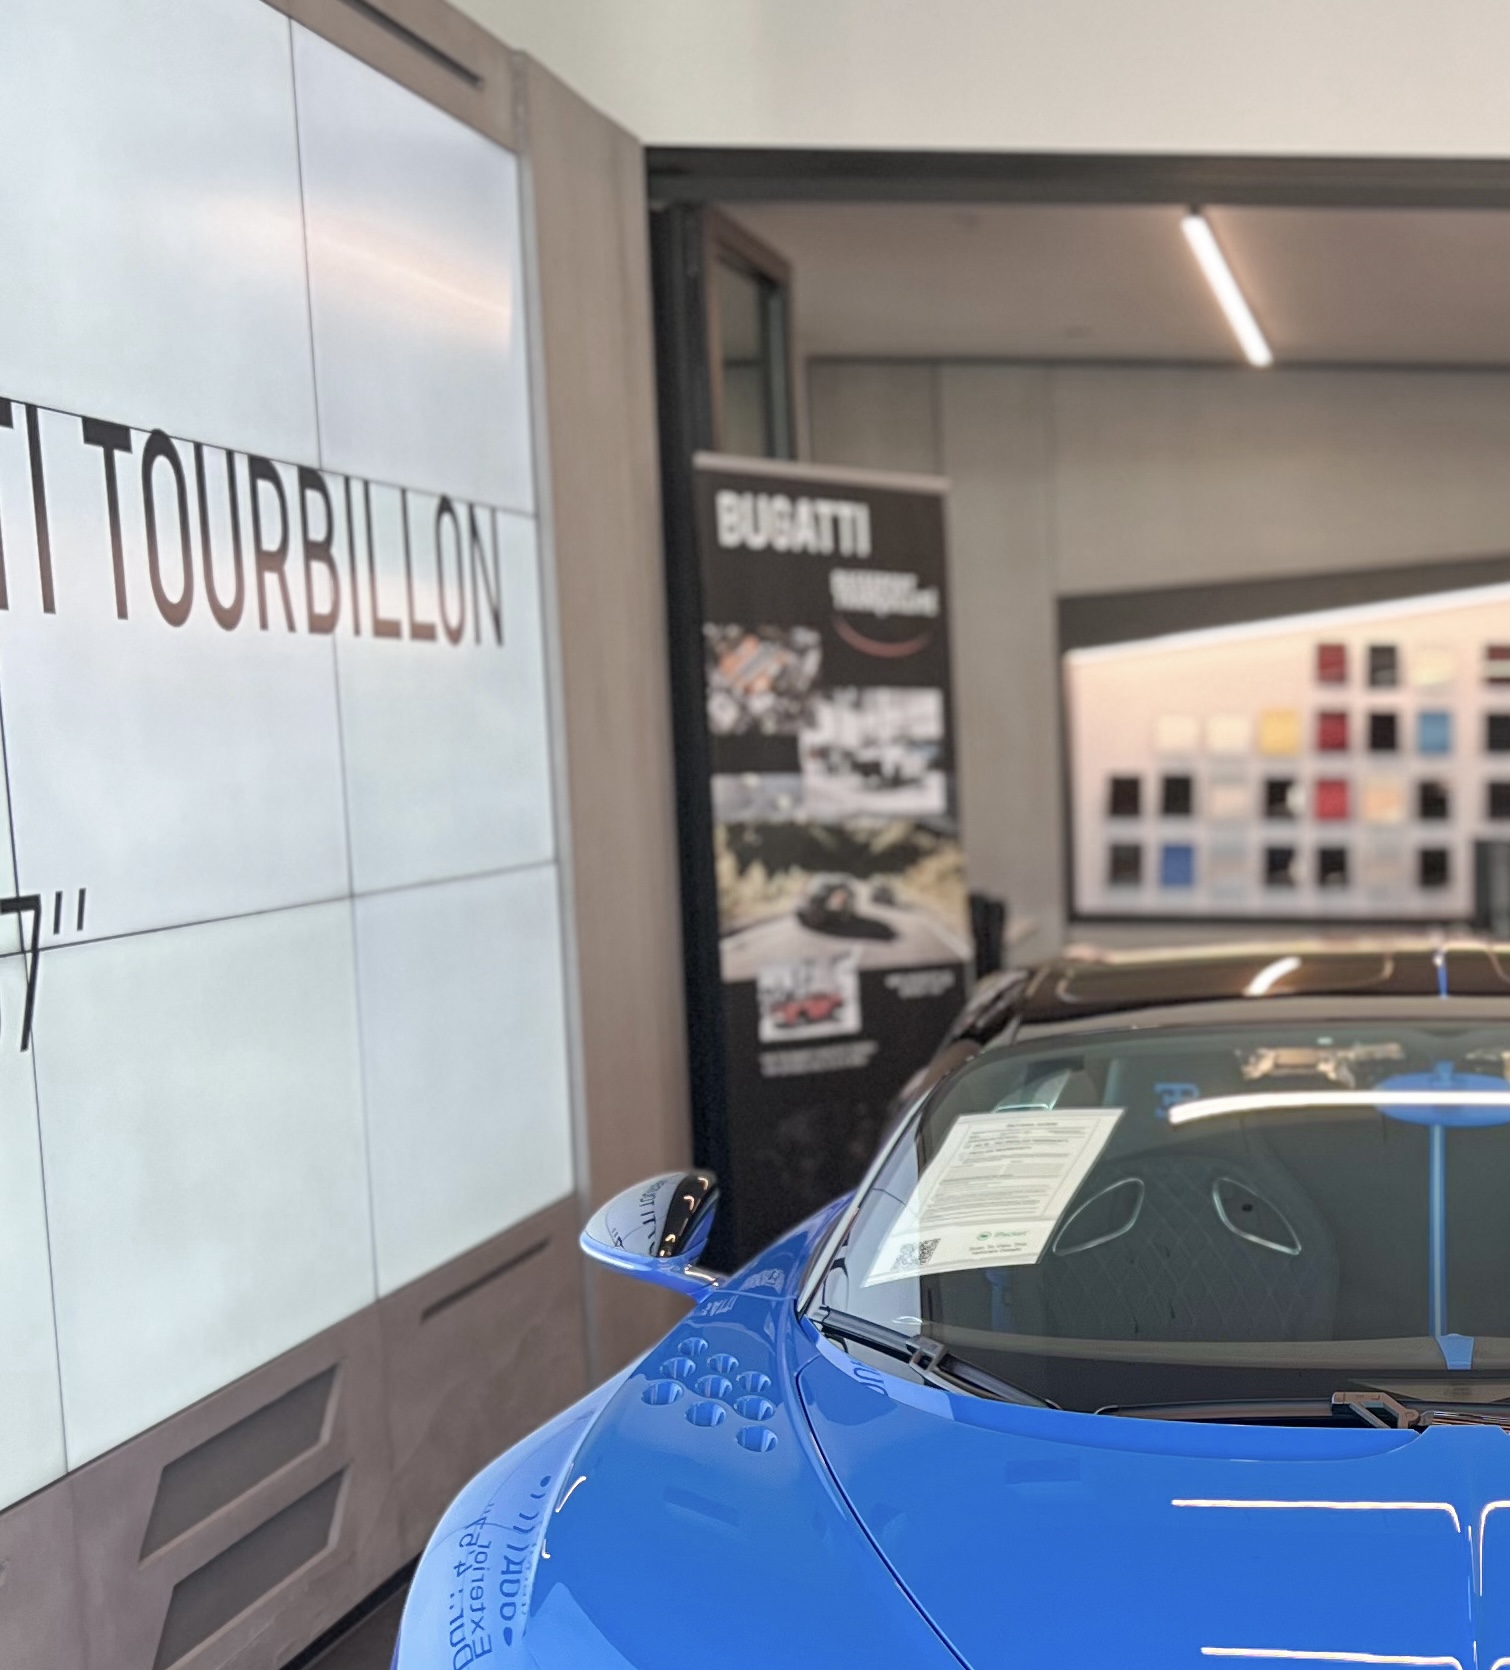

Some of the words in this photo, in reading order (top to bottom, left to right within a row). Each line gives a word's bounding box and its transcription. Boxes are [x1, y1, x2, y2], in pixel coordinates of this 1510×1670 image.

[0, 396, 57, 614] I
[82, 416, 504, 646] TOURBILLON
[715, 490, 872, 558] BUGATTI
